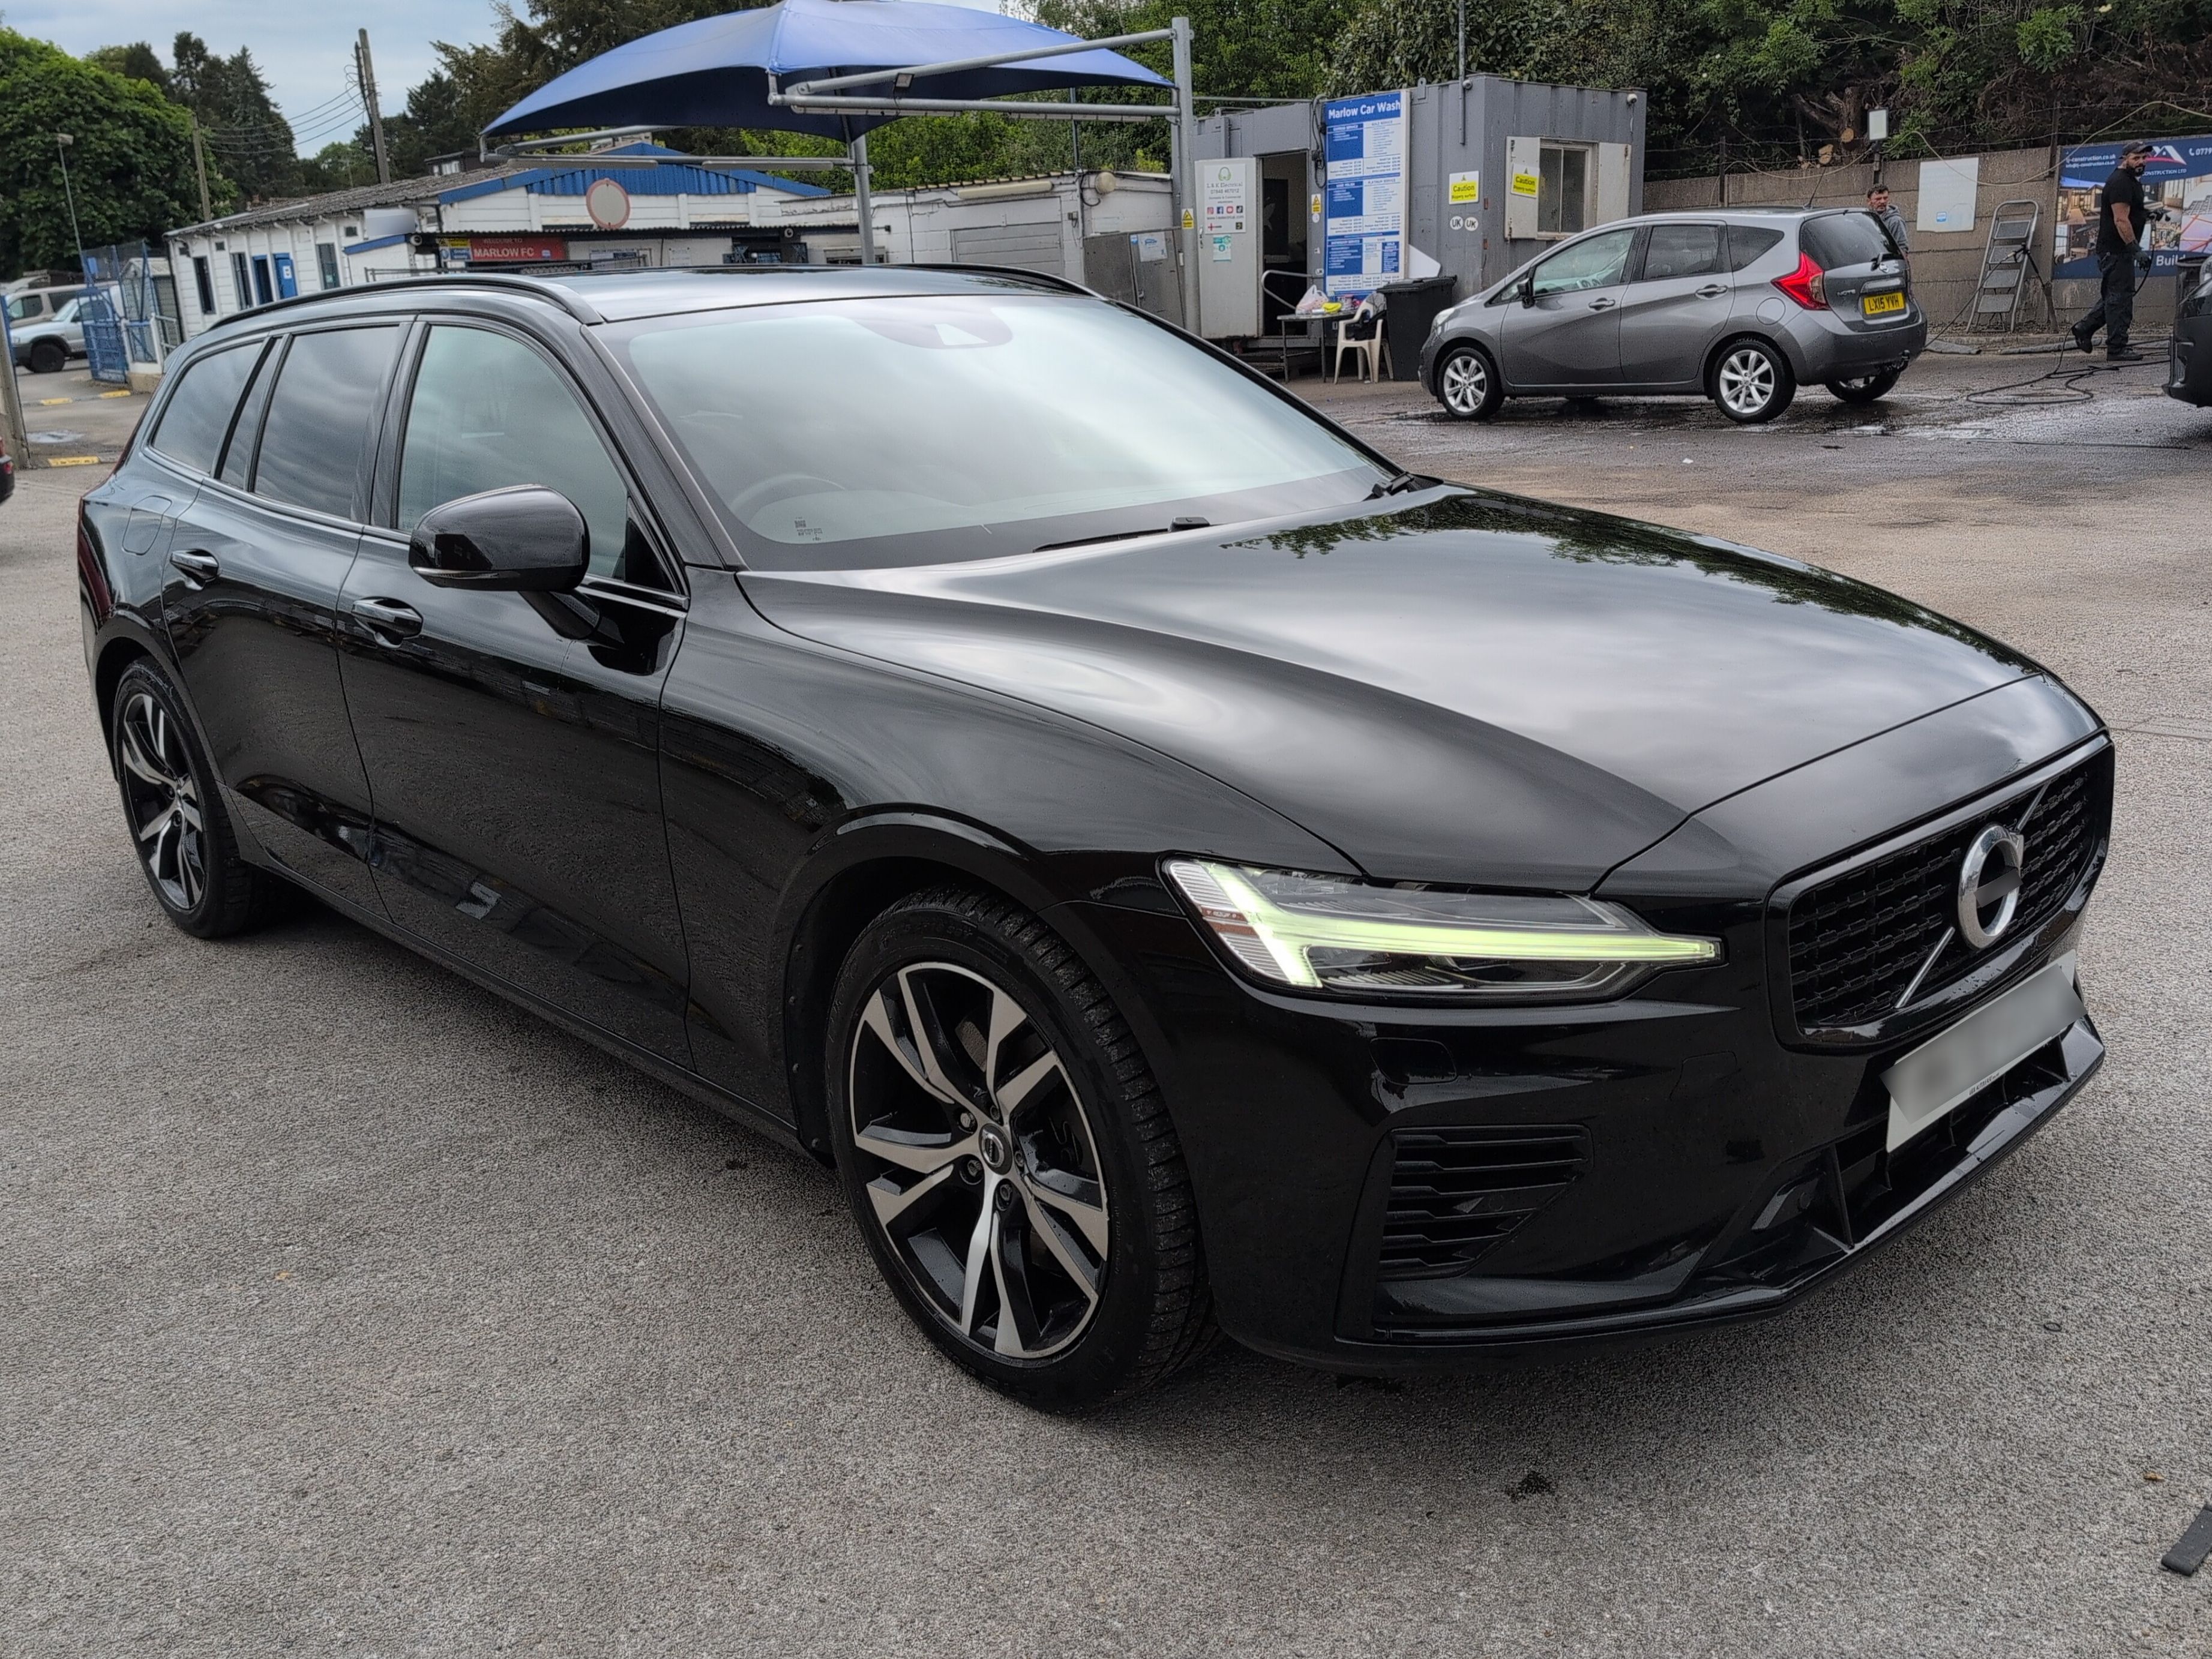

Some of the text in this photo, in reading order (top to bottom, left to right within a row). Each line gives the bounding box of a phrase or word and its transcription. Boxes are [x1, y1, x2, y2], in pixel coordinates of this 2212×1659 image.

[1328, 100, 1401, 119] Marlow Car Wash
[1515, 176, 1535, 186] Caution
[473, 248, 519, 257] MARLOW
[521, 247, 535, 257] FC
[1868, 295, 1899, 311] LX15 YVH
